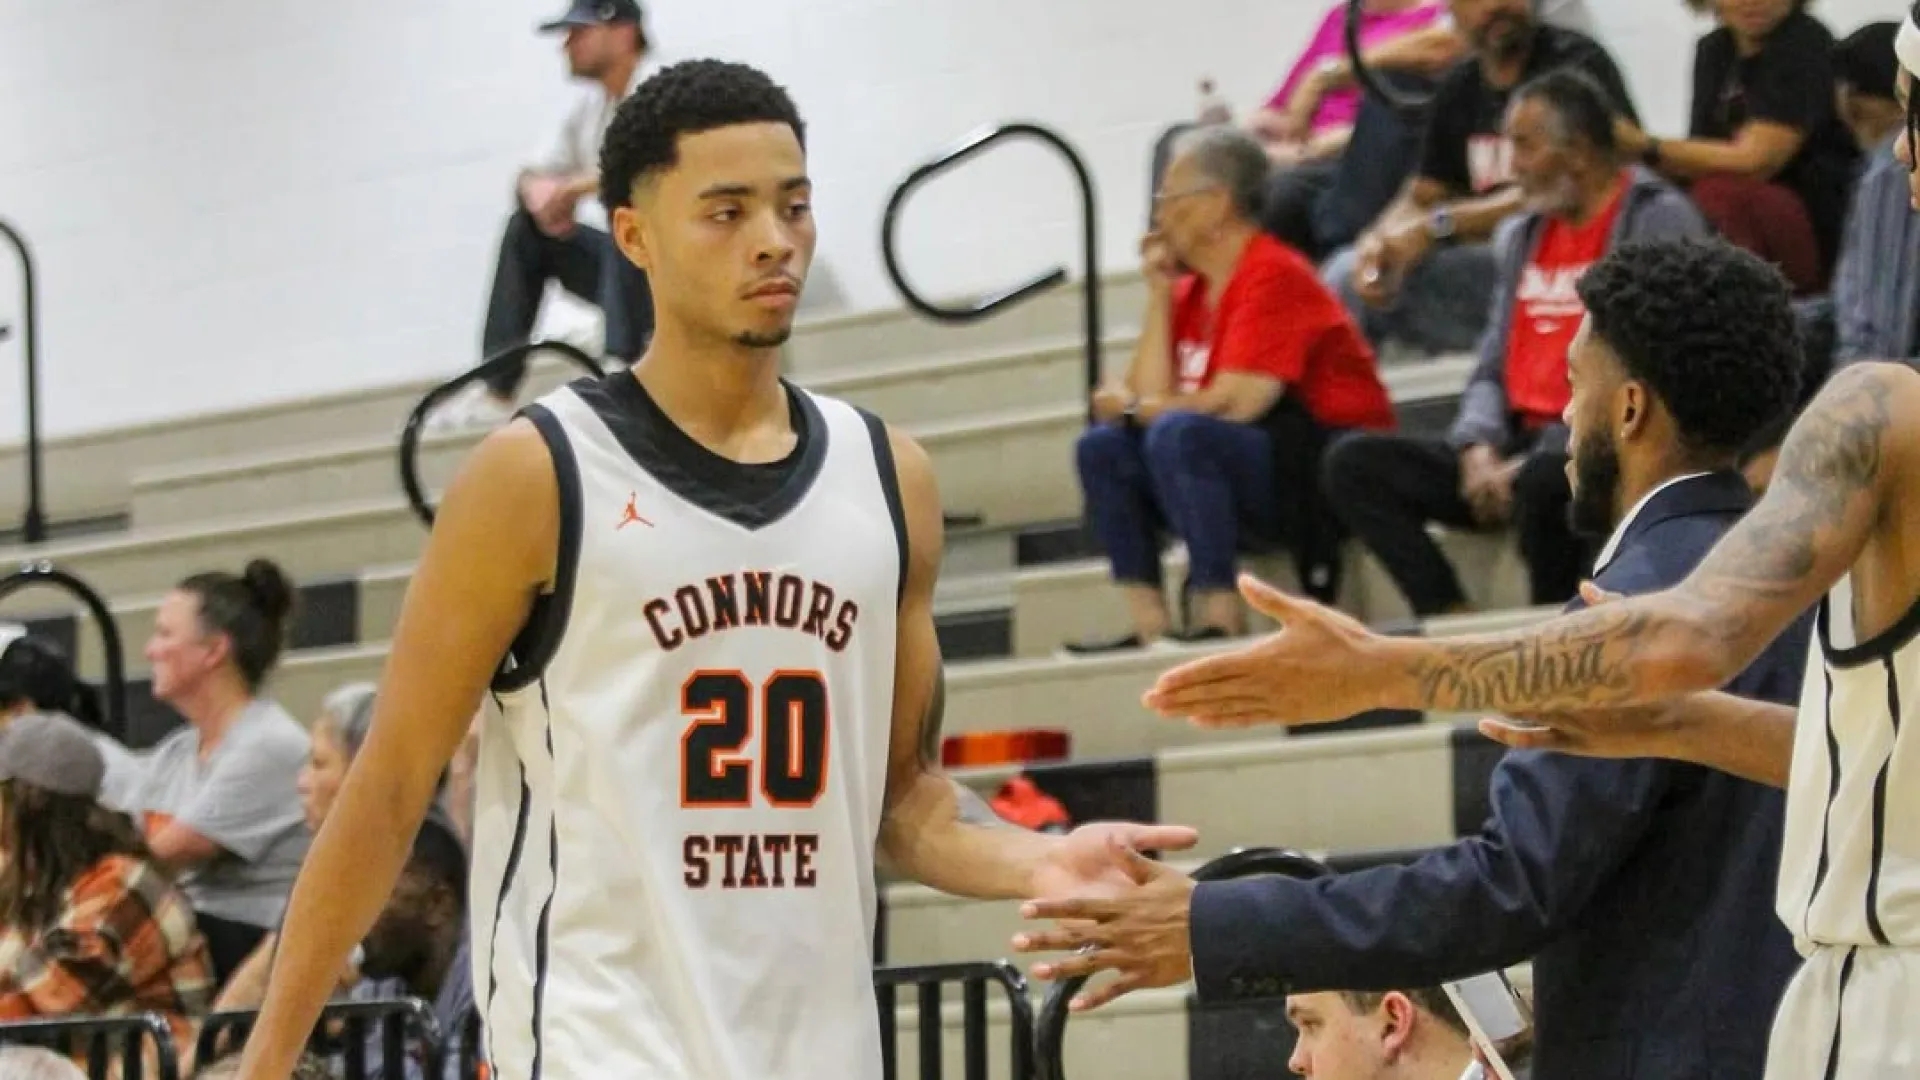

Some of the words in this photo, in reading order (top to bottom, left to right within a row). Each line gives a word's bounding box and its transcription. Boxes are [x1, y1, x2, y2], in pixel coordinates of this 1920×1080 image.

[643, 571, 859, 653] CONNORS
[680, 668, 831, 809] 20
[683, 835, 819, 888] STATE
